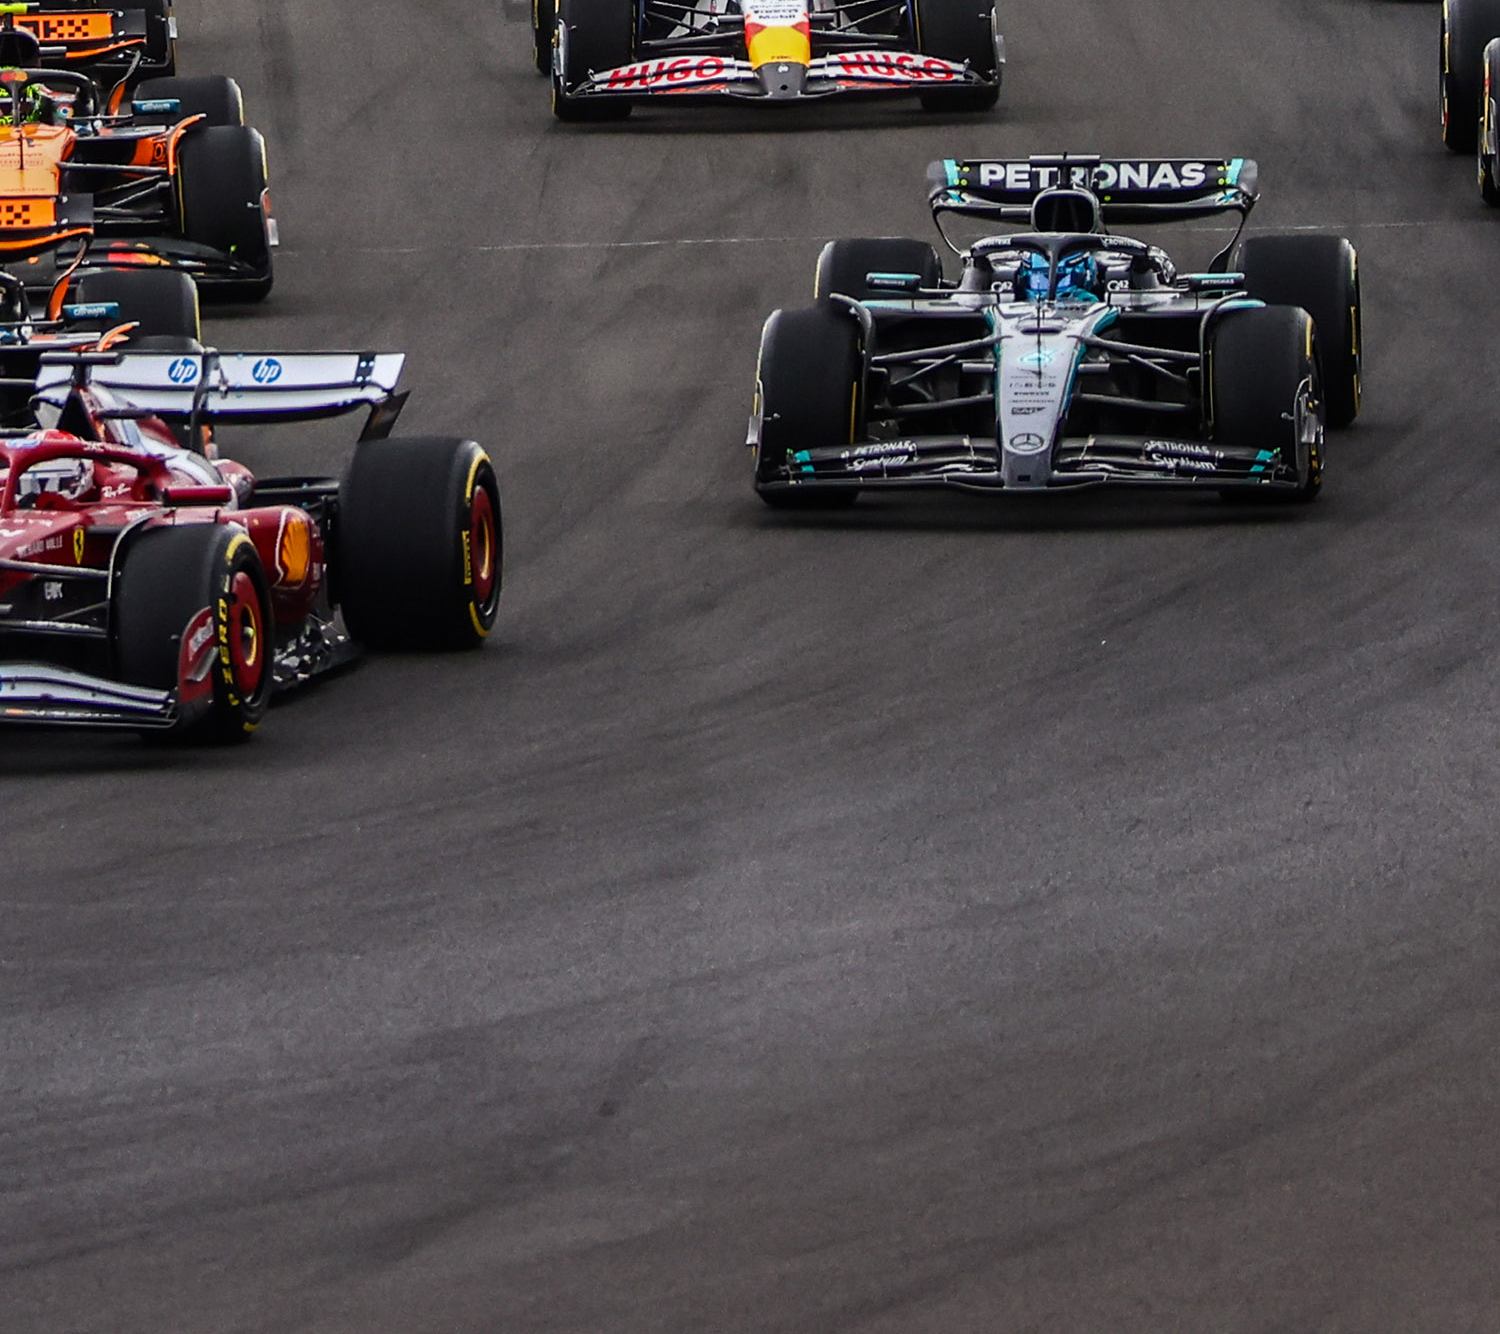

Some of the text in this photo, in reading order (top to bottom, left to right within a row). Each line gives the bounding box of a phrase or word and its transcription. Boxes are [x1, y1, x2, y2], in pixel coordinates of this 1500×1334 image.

[606, 56, 725, 89] HUGO
[839, 52, 955, 82] HUGO
[980, 162, 1207, 190] PETRONAS
[171, 359, 198, 384] hp
[254, 359, 281, 384] hp
[853, 440, 912, 457] PETRONAS
[1150, 439, 1211, 456] PETRONAS
